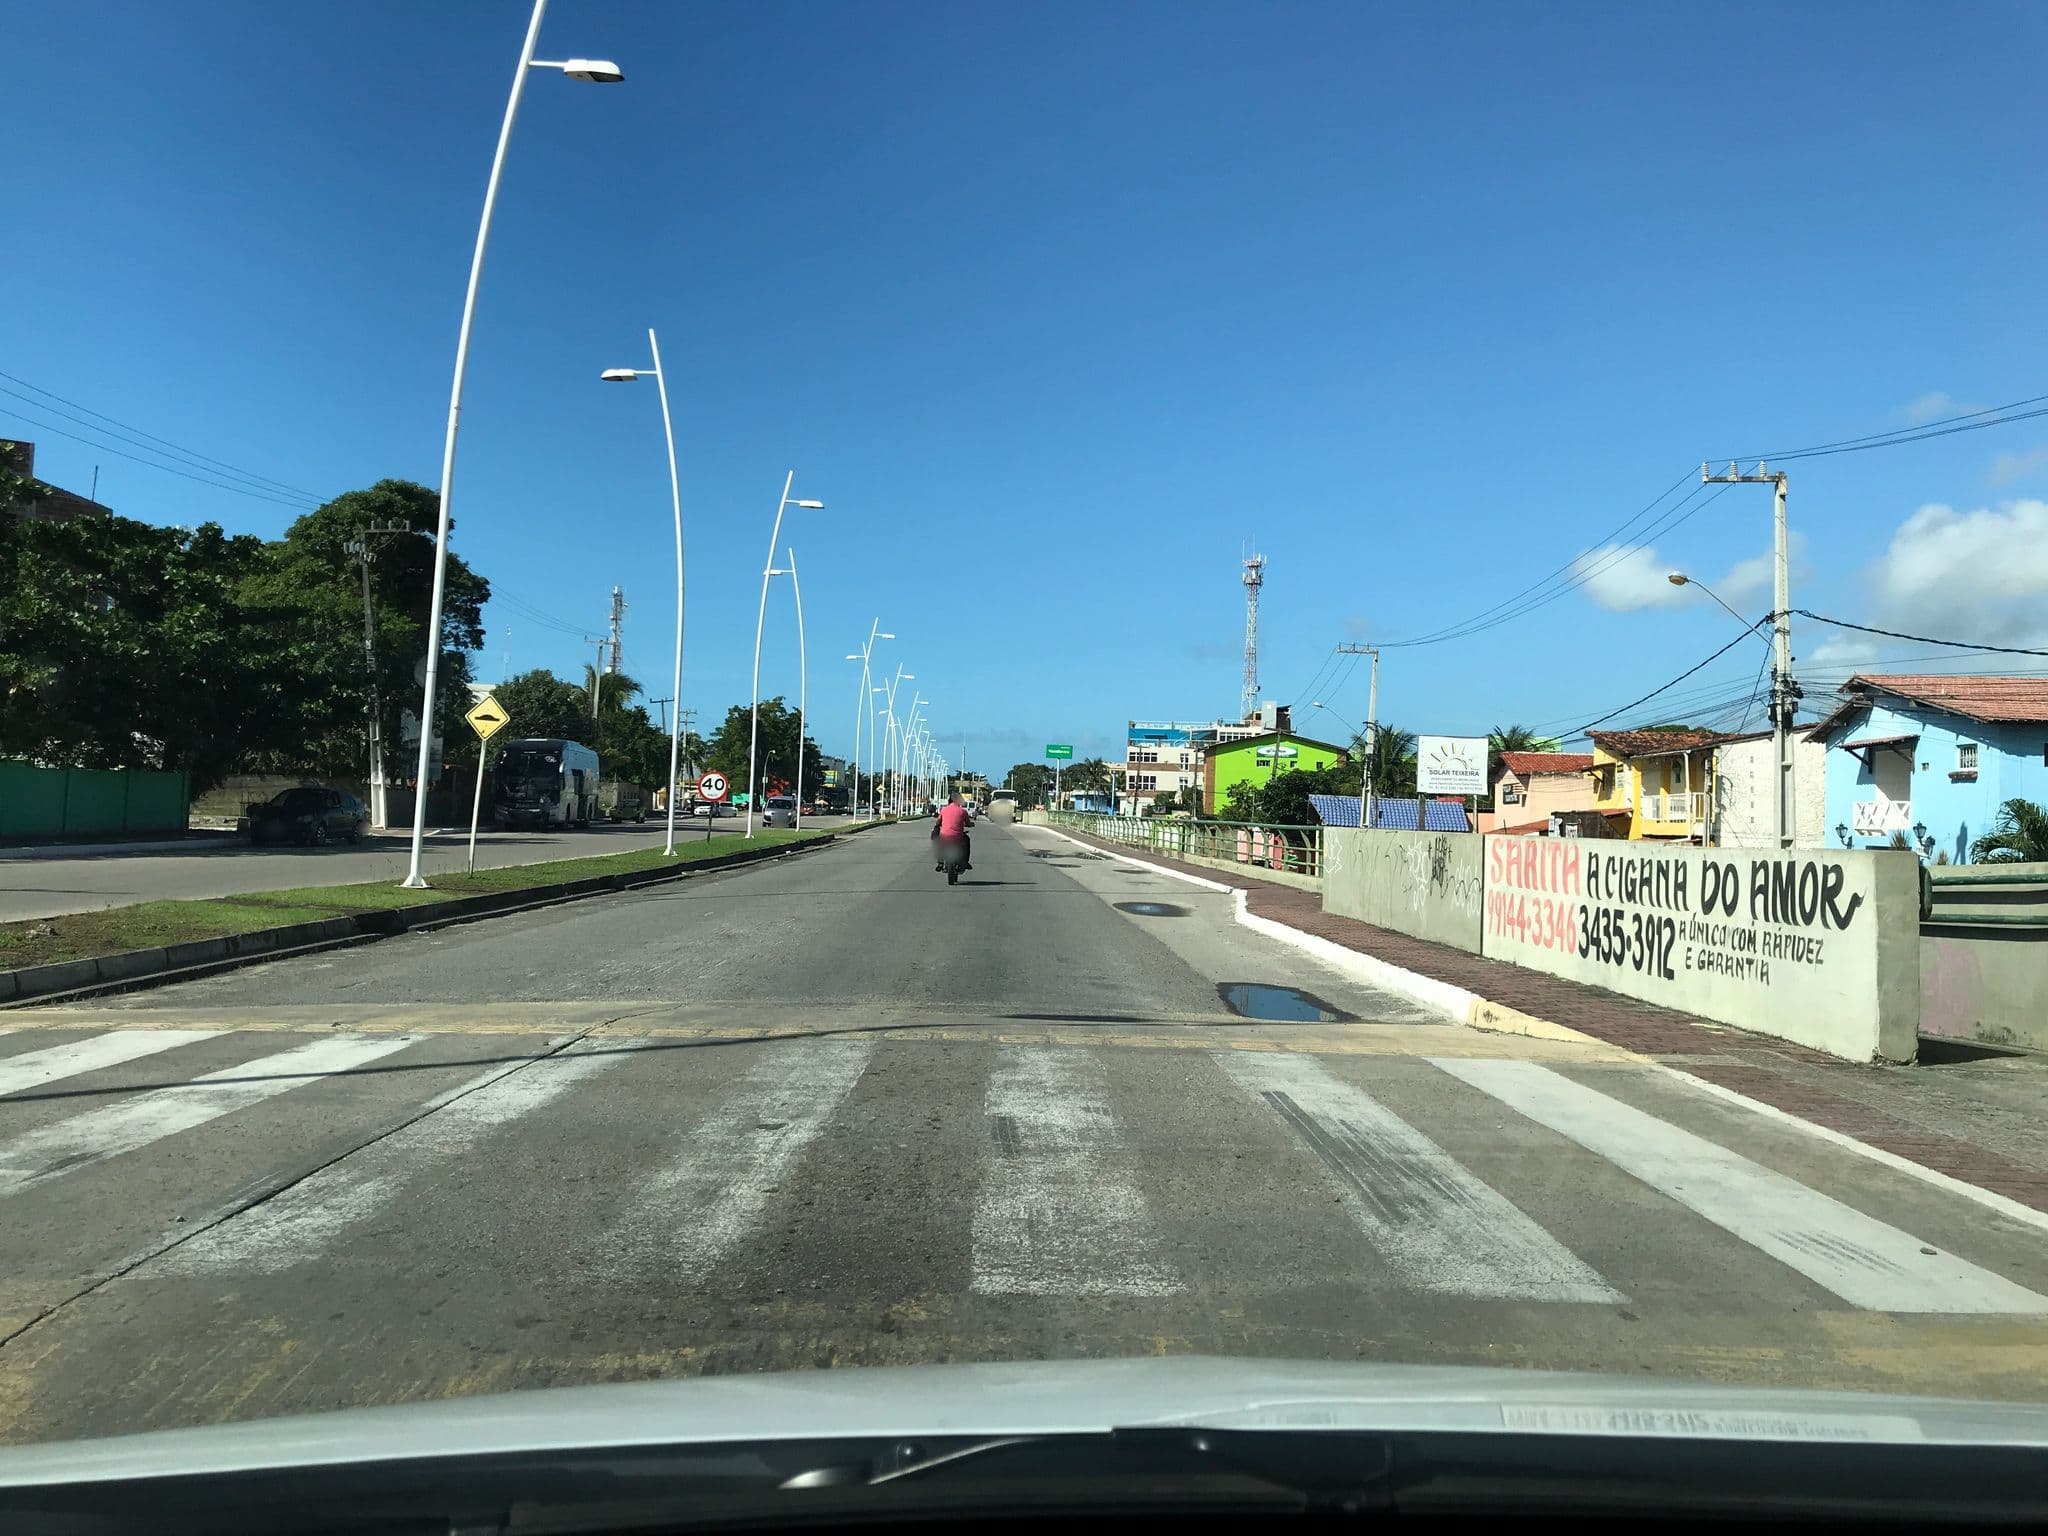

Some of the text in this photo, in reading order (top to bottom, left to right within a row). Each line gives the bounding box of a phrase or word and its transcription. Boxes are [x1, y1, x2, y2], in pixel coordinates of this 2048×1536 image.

[702, 778, 725, 790] 40
[1490, 838, 1581, 896] SARITA
[1587, 851, 1602, 900] A
[1605, 855, 1690, 912] CIGANA
[1700, 859, 1740, 917] DO
[1750, 859, 1866, 931] AMOR
[1679, 920, 1687, 942] A
[1731, 925, 1758, 954] COM
[1685, 946, 1771, 986] E GARANTIA
